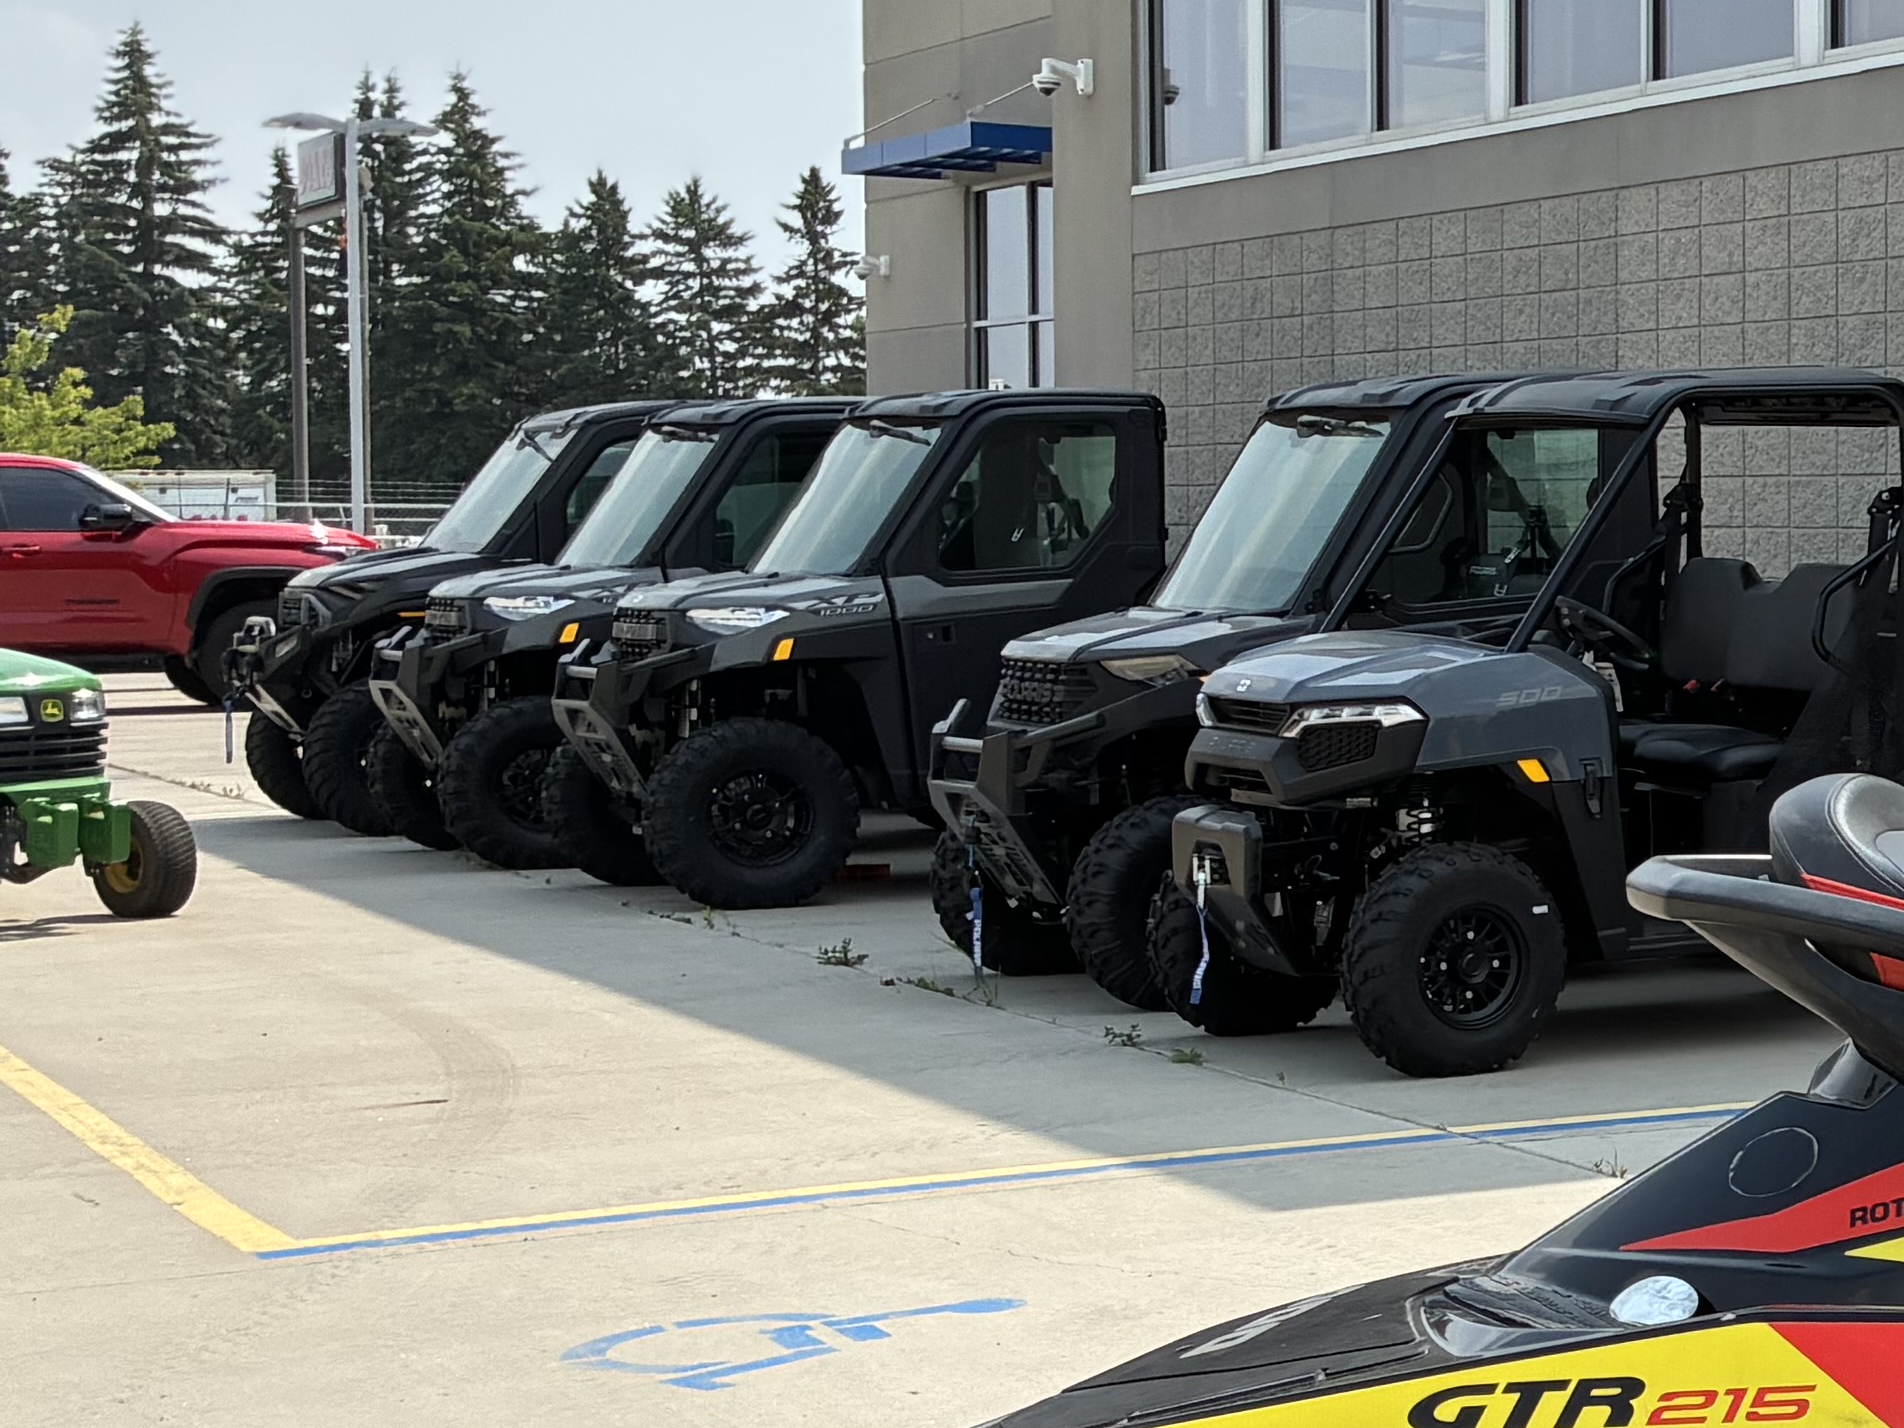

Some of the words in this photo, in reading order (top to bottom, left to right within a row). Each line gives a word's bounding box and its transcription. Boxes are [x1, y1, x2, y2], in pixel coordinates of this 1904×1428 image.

[819, 604, 879, 617] 1000
[1000, 678, 1053, 704] POLARIS
[1495, 685, 1563, 708] 500
[1645, 1384, 1818, 1427] 215
